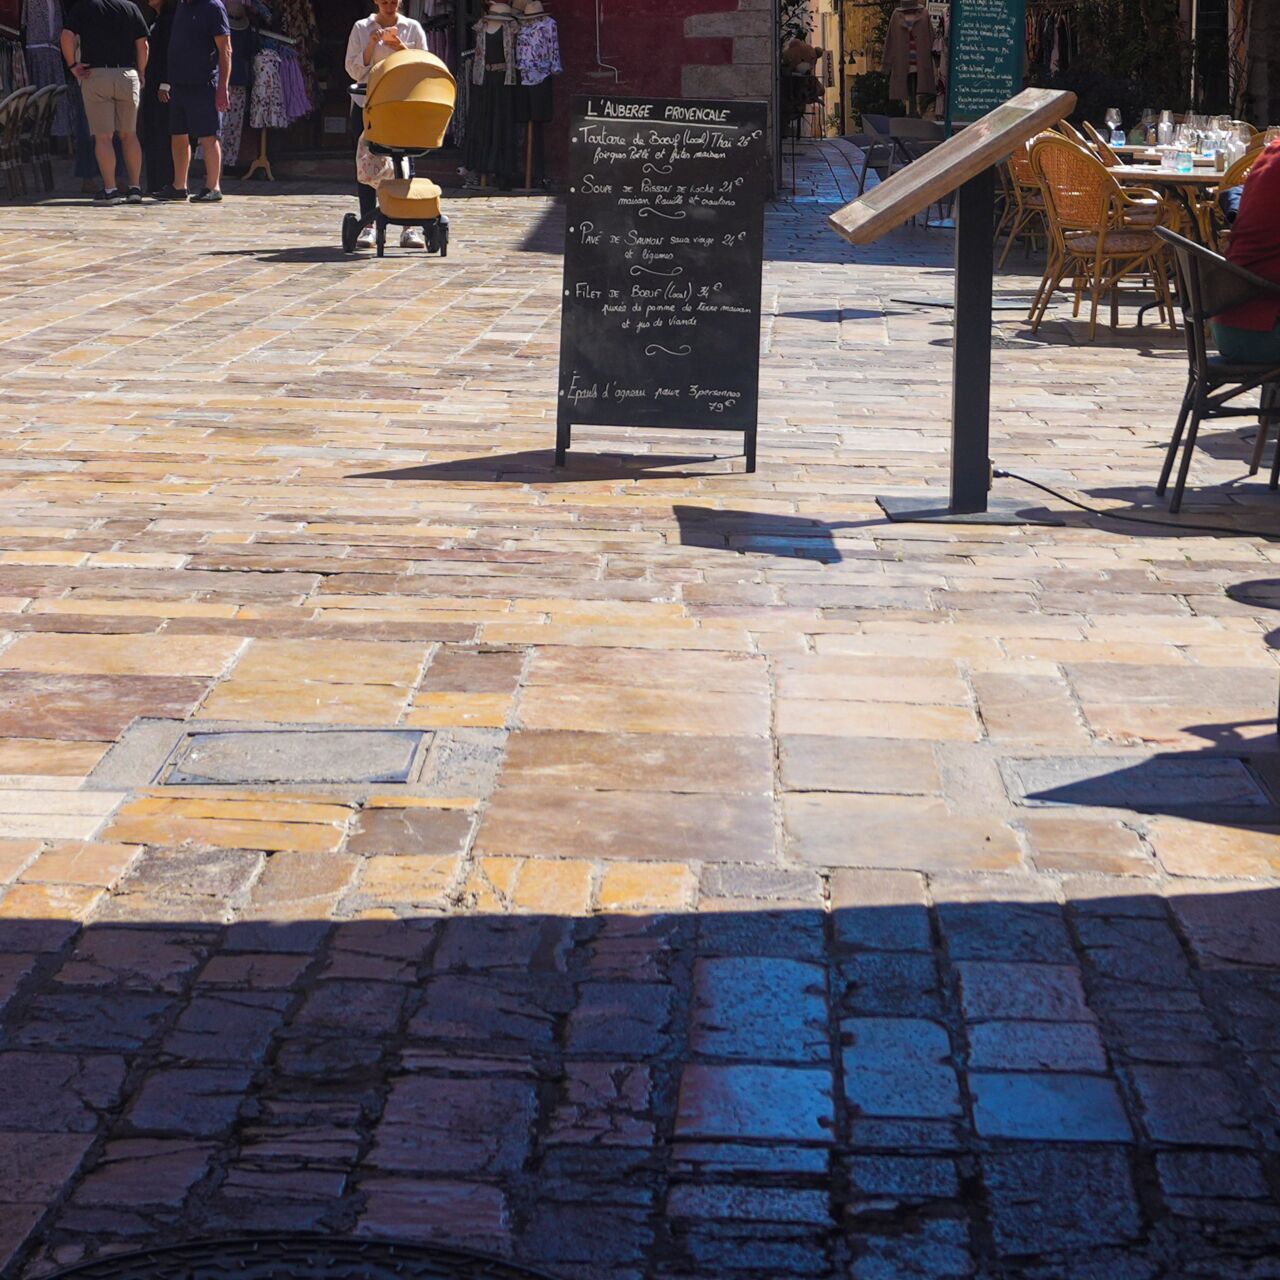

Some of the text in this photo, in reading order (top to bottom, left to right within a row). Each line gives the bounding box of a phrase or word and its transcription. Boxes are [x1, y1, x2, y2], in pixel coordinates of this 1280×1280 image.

[586, 100, 654, 118] L'AUBERGE
[578, 125, 627, 146] Tartare
[632, 133, 646, 146] de
[654, 149, 667, 160] et
[693, 151, 726, 160] maison
[618, 195, 652, 206] maison
[687, 195, 701, 206] et
[624, 249, 635, 259] et
[632, 303, 643, 313] de
[682, 303, 693, 313] de
[621, 318, 632, 329] et
[653, 317, 664, 328] de
[653, 388, 681, 400] pour
